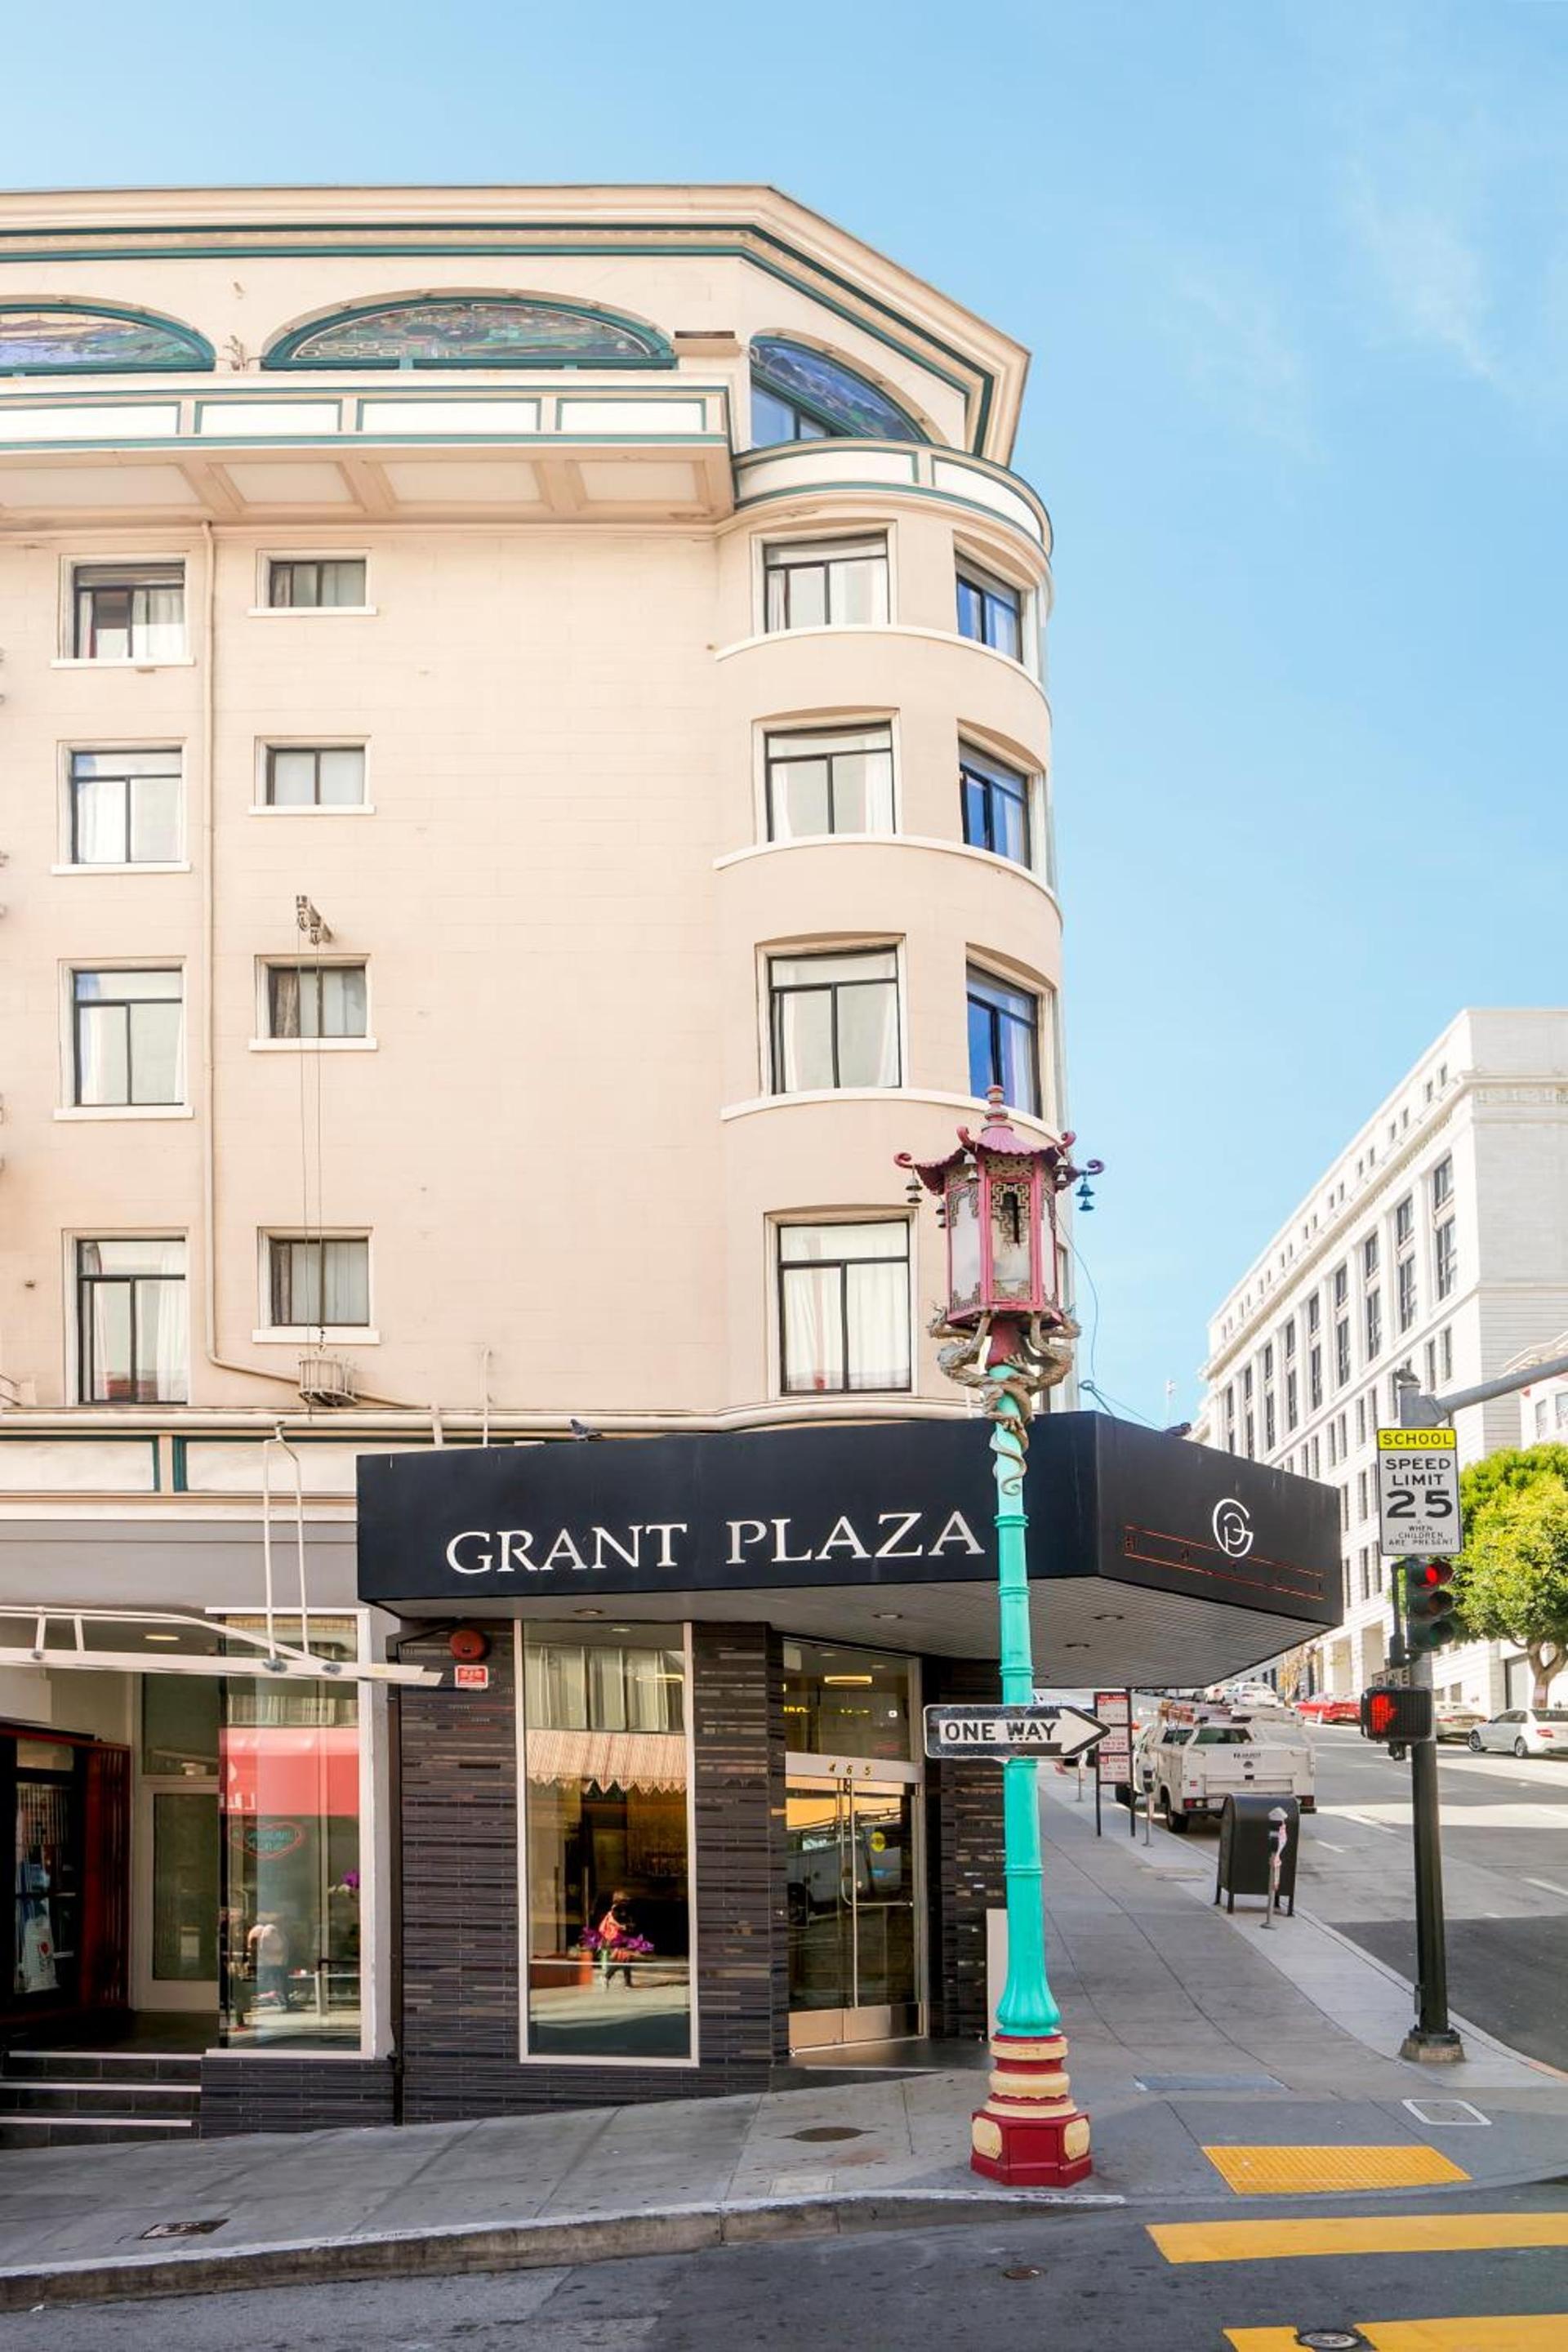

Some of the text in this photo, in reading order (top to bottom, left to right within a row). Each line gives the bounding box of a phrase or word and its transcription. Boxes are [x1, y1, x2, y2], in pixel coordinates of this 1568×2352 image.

[1383, 1432, 1453, 1446] SCHOOL
[1385, 1458, 1451, 1470] SPEED
[1392, 1474, 1444, 1486] LIMIT
[1386, 1490, 1453, 1519] 25
[446, 1510, 986, 1575] GRANT PLAZA
[945, 1722, 1057, 1741] ONE WAY
